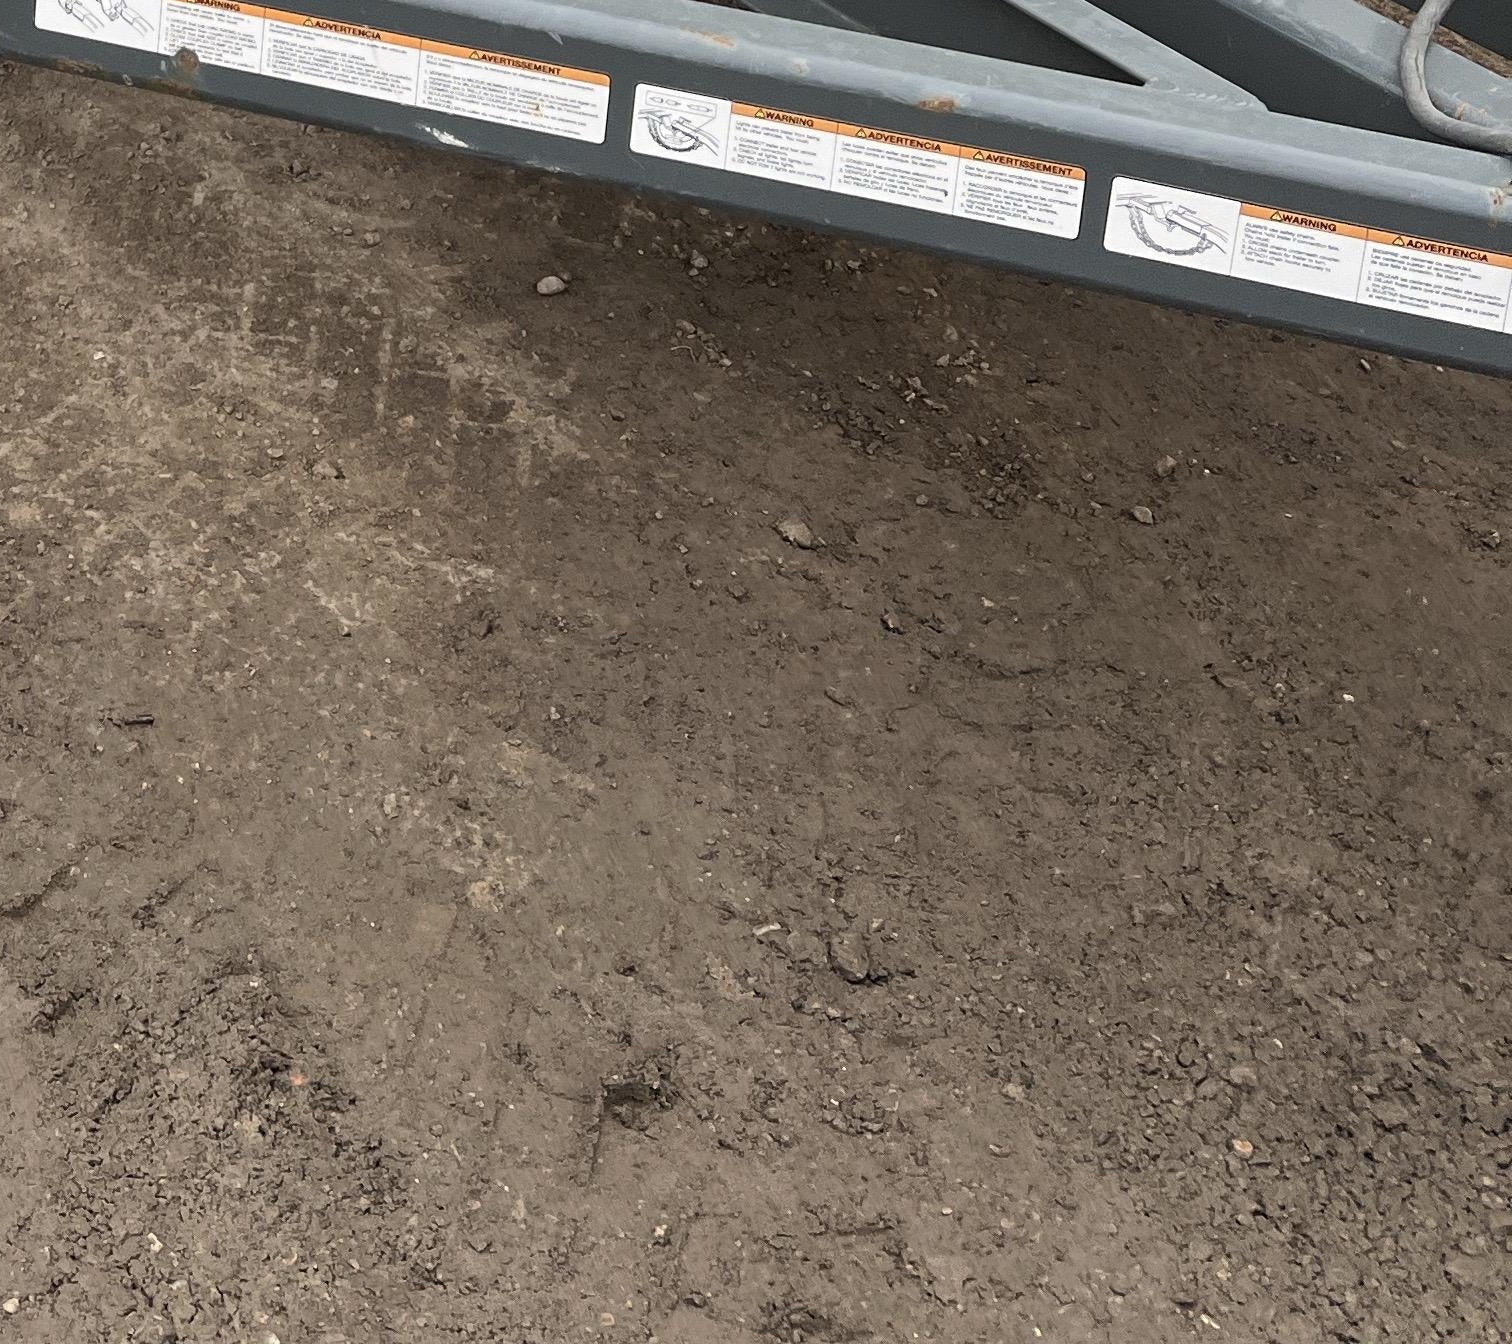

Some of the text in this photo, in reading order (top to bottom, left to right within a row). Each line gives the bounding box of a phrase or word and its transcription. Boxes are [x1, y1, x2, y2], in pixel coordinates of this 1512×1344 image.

[315, 20, 382, 40] ADVERTENCIA
[481, 53, 561, 76] AVERTISSEMENT
[765, 111, 814, 128] WARNING
[868, 131, 941, 152] ADVERTENCIA
[986, 153, 1072, 176] AVERTISSEMENT
[1282, 214, 1337, 232] WARNING
[1406, 239, 1488, 262] ADVERTENCIA
